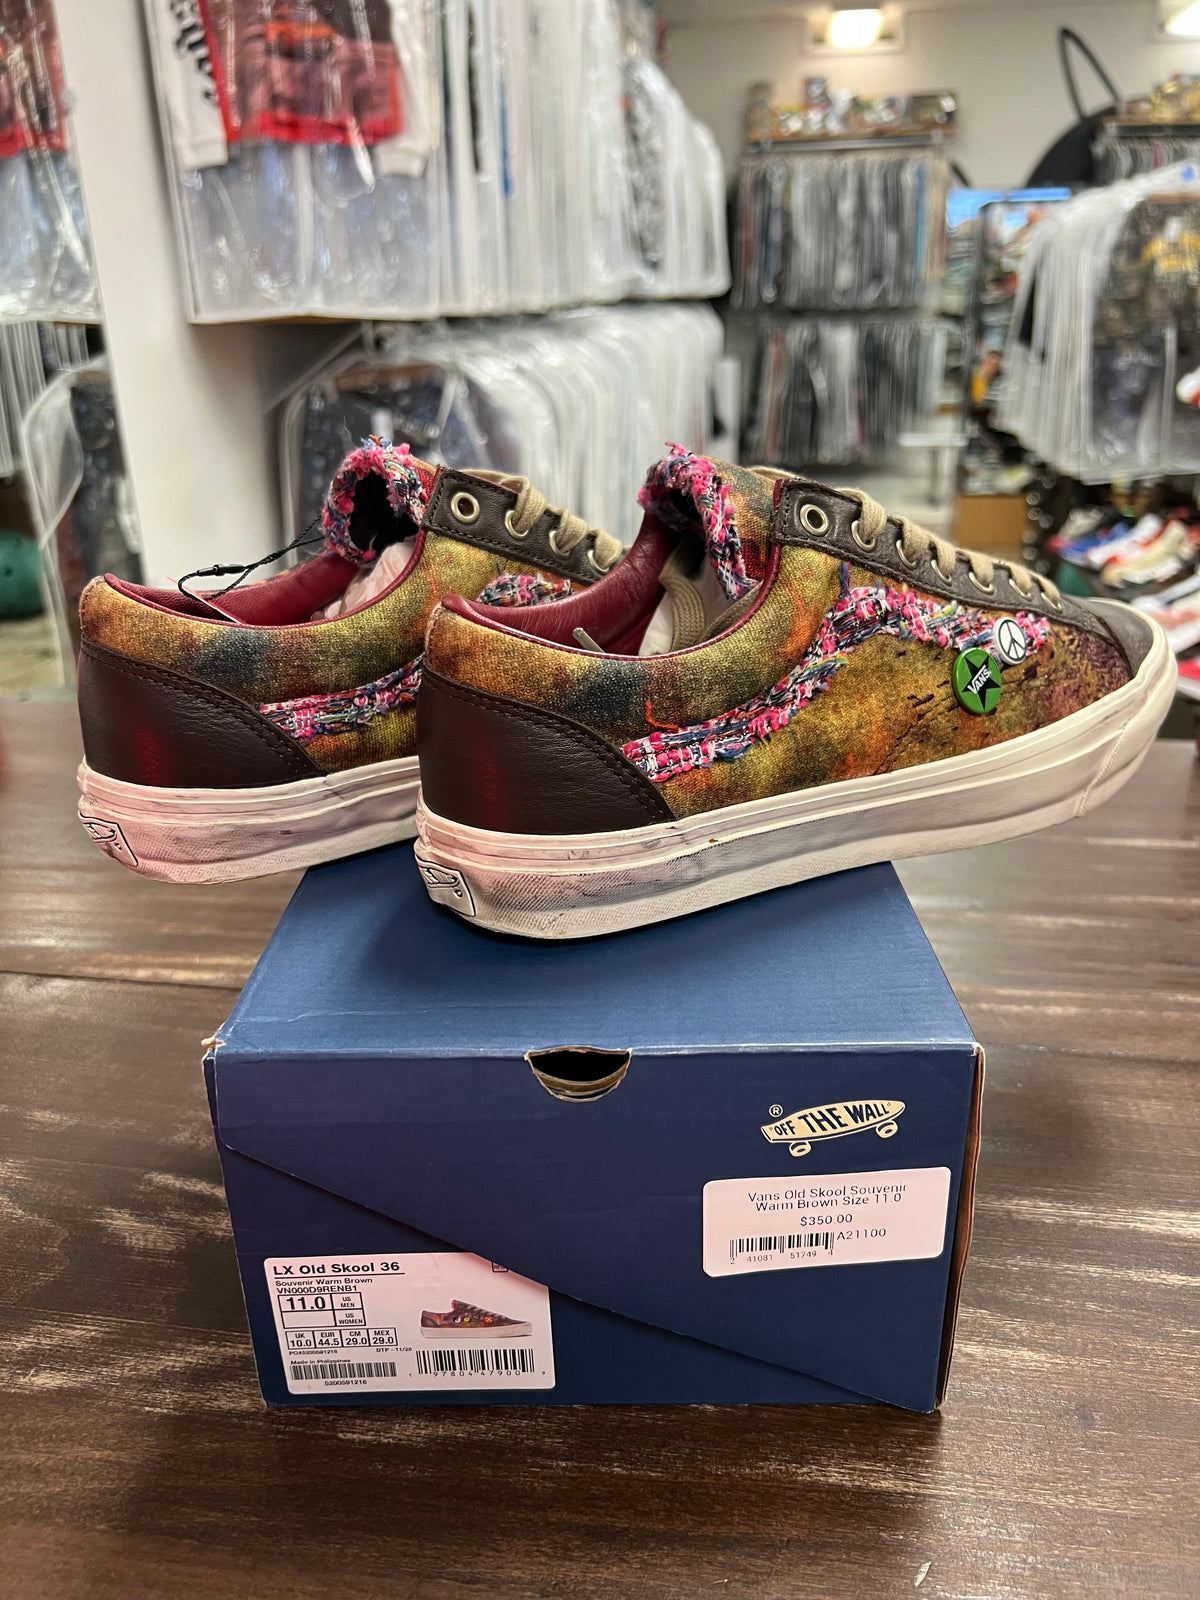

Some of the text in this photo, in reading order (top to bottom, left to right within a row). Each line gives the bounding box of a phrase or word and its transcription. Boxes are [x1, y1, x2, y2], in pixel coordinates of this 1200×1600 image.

[967, 664, 992, 694] VANS
[798, 1107, 848, 1133] THE
[748, 1182, 907, 1202] Vans Old Skool Souvenir
[755, 1193, 902, 1212] Warm Brown Size 11.0
[800, 1214, 853, 1226] $350.00
[837, 1228, 887, 1240] A21100
[273, 1262, 400, 1276] LX Old Skool 36
[276, 1285, 358, 1294] VN000D9RENB1
[286, 1296, 326, 1310] 11.0
[290, 1339, 312, 1347] 10.0
[317, 1338, 340, 1346] 44.5
[345, 1337, 368, 1345] 29.0
[372, 1336, 394, 1345] 29.0
